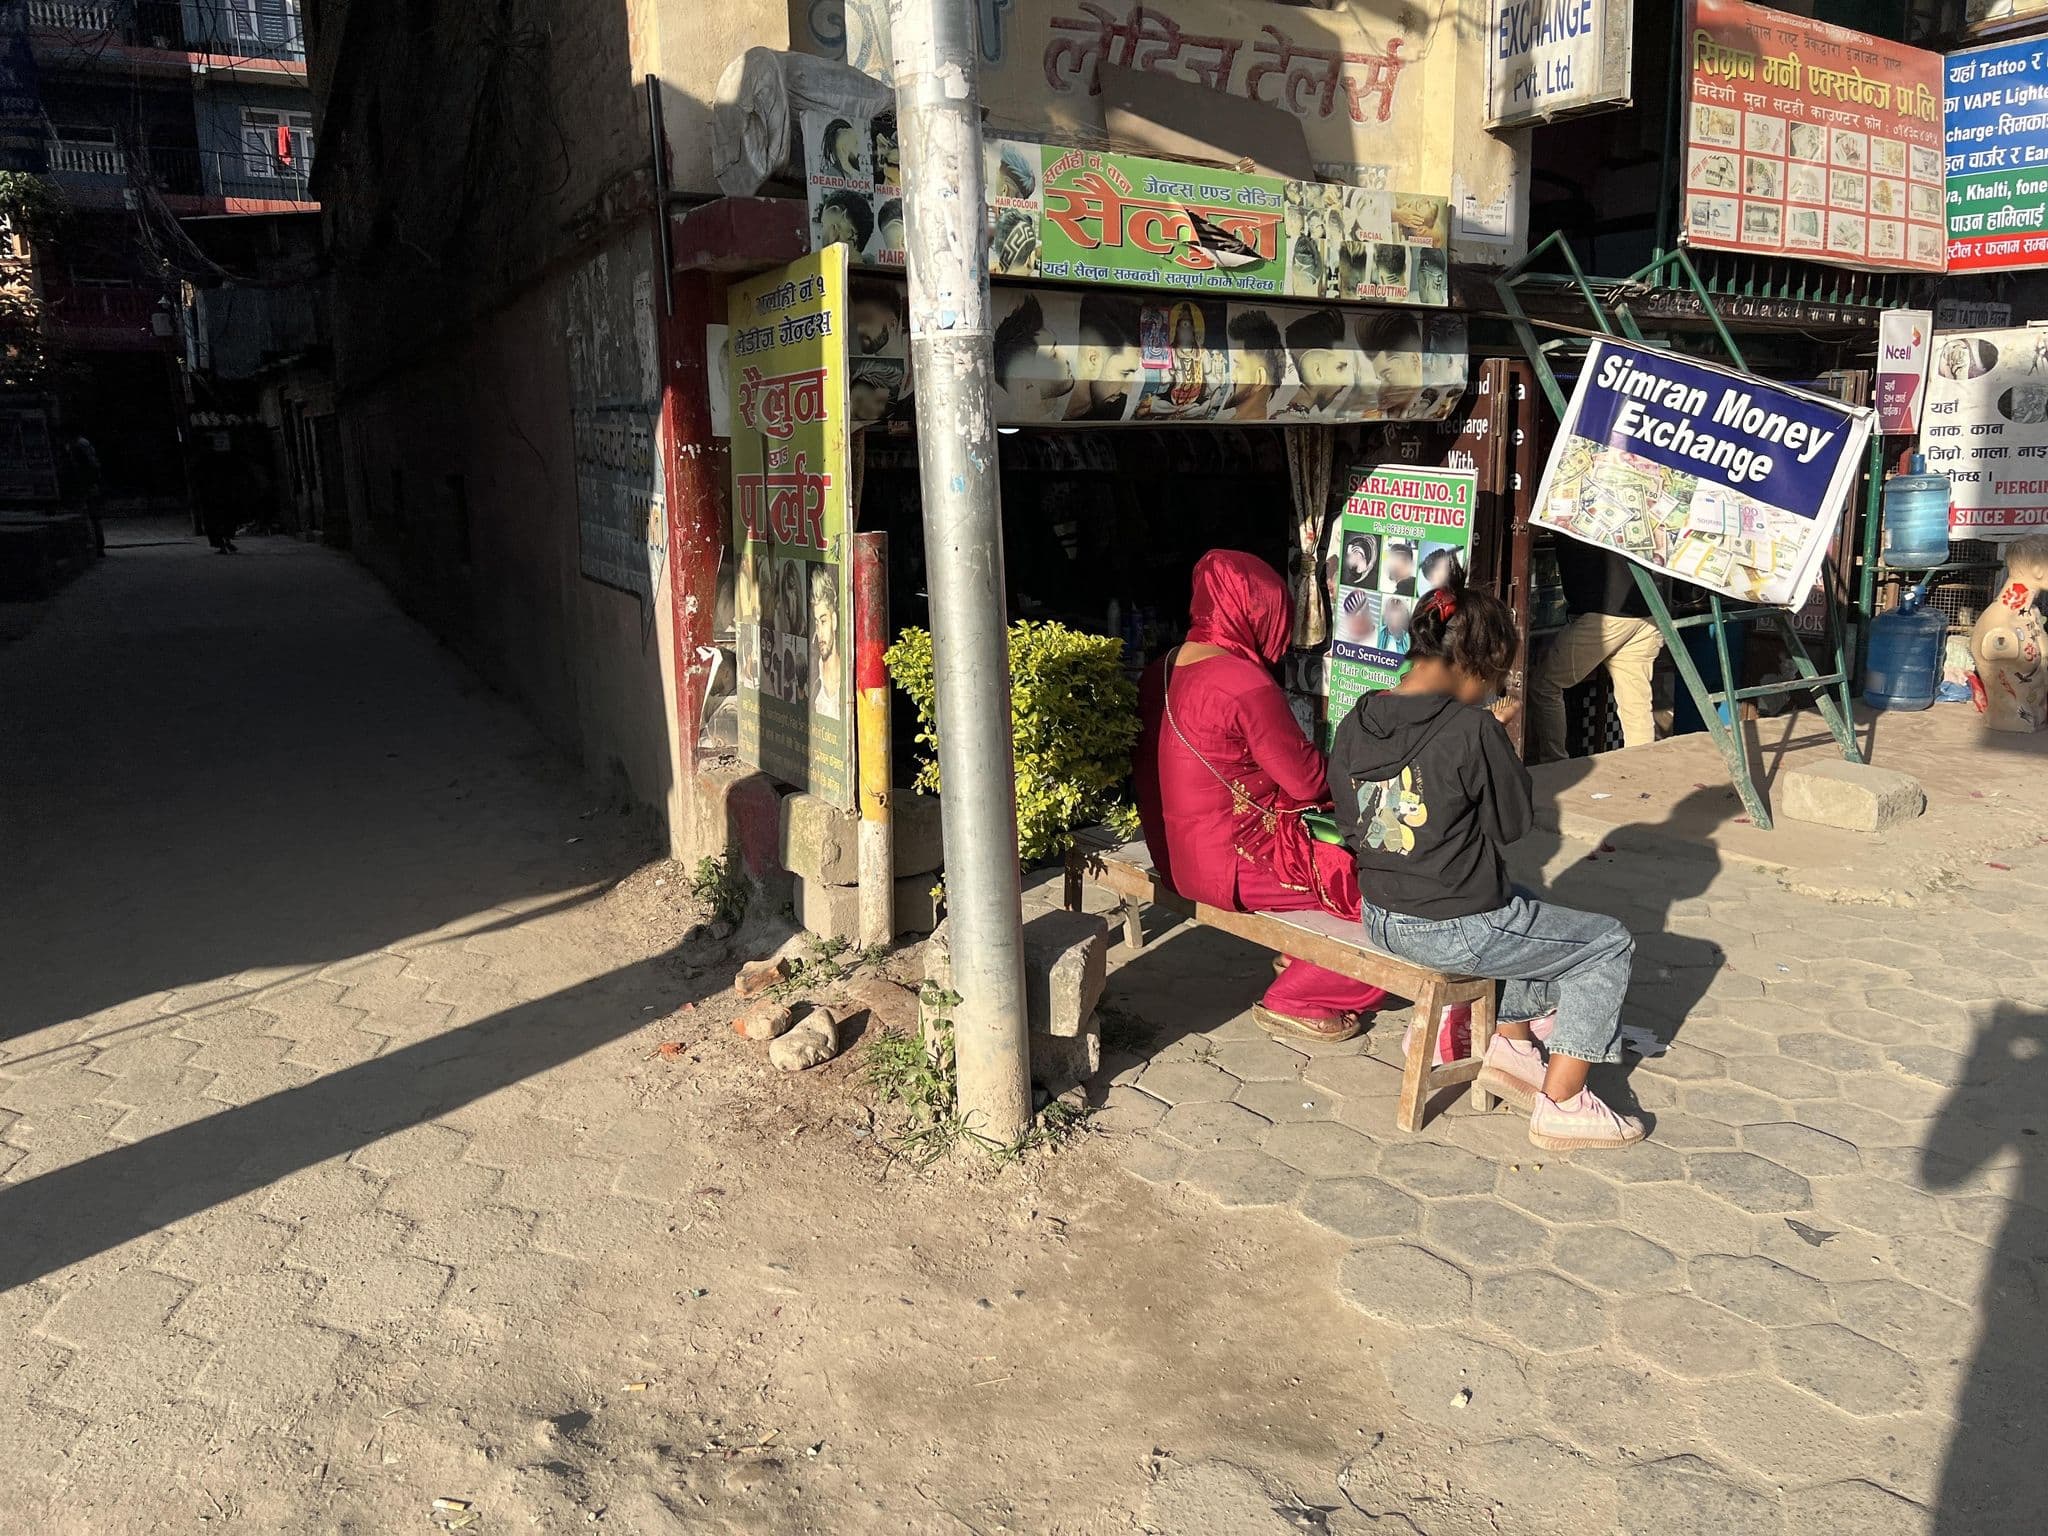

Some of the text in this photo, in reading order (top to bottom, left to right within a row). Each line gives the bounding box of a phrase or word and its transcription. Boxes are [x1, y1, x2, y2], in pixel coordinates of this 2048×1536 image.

[1500, 0, 1591, 59] EXCHANGE
[1514, 55, 1574, 102] Pvt. Ltd.
[1762, 51, 1802, 92] मनी
[1808, 66, 1892, 110] एक्सचेन्ज
[1949, 52, 2044, 84] यहाँ Tattoo र
[1693, 78, 1737, 104] विदेशी
[1743, 92, 1767, 111] मुद्रा
[1773, 98, 1805, 118] सटही
[1811, 105, 1861, 128] काउण्टर
[1864, 114, 1882, 130] फोन
[1963, 90, 2002, 111] VAPE
[2010, 147, 2022, 164] र
[846, 179, 871, 190] LOCK
[876, 184, 894, 196] HAIR
[1199, 185, 1231, 201] एण्ड
[1236, 186, 1284, 207] लेडिज
[1966, 181, 2012, 200] Khalti,
[995, 197, 1038, 210] HAIR COLOUR
[1045, 171, 1284, 269] सैलुन
[1950, 203, 2046, 232] पाउन हामिलाई
[1359, 231, 1384, 242] FACIAL
[1974, 243, 1983, 256] र
[1985, 240, 2021, 255] फलाम
[878, 249, 905, 265] HAIR
[1074, 262, 1109, 281] सैलुन
[1113, 264, 1160, 283] सम्बन्धी
[1206, 276, 1233, 289] काम
[1357, 284, 1407, 298] HAIR CUTTING
[1732, 295, 1801, 320] Collected
[1885, 344, 1912, 361] Ncell
[738, 366, 828, 440] सैलुन
[1596, 354, 1834, 464] Simran Money
[1437, 414, 1489, 441] Recharge
[1970, 423, 2005, 435] कान
[1612, 399, 1774, 484] Exchange
[1448, 450, 1474, 470] With
[736, 451, 831, 552] पार्लर
[1349, 475, 1467, 503] SARLAHI NO. 1
[1346, 498, 1466, 528] HAIR CUTTING
[1954, 509, 2005, 525] SINCE
[1336, 644, 1399, 668] Our Services:
[1338, 661, 1397, 687] Hair Cutting
